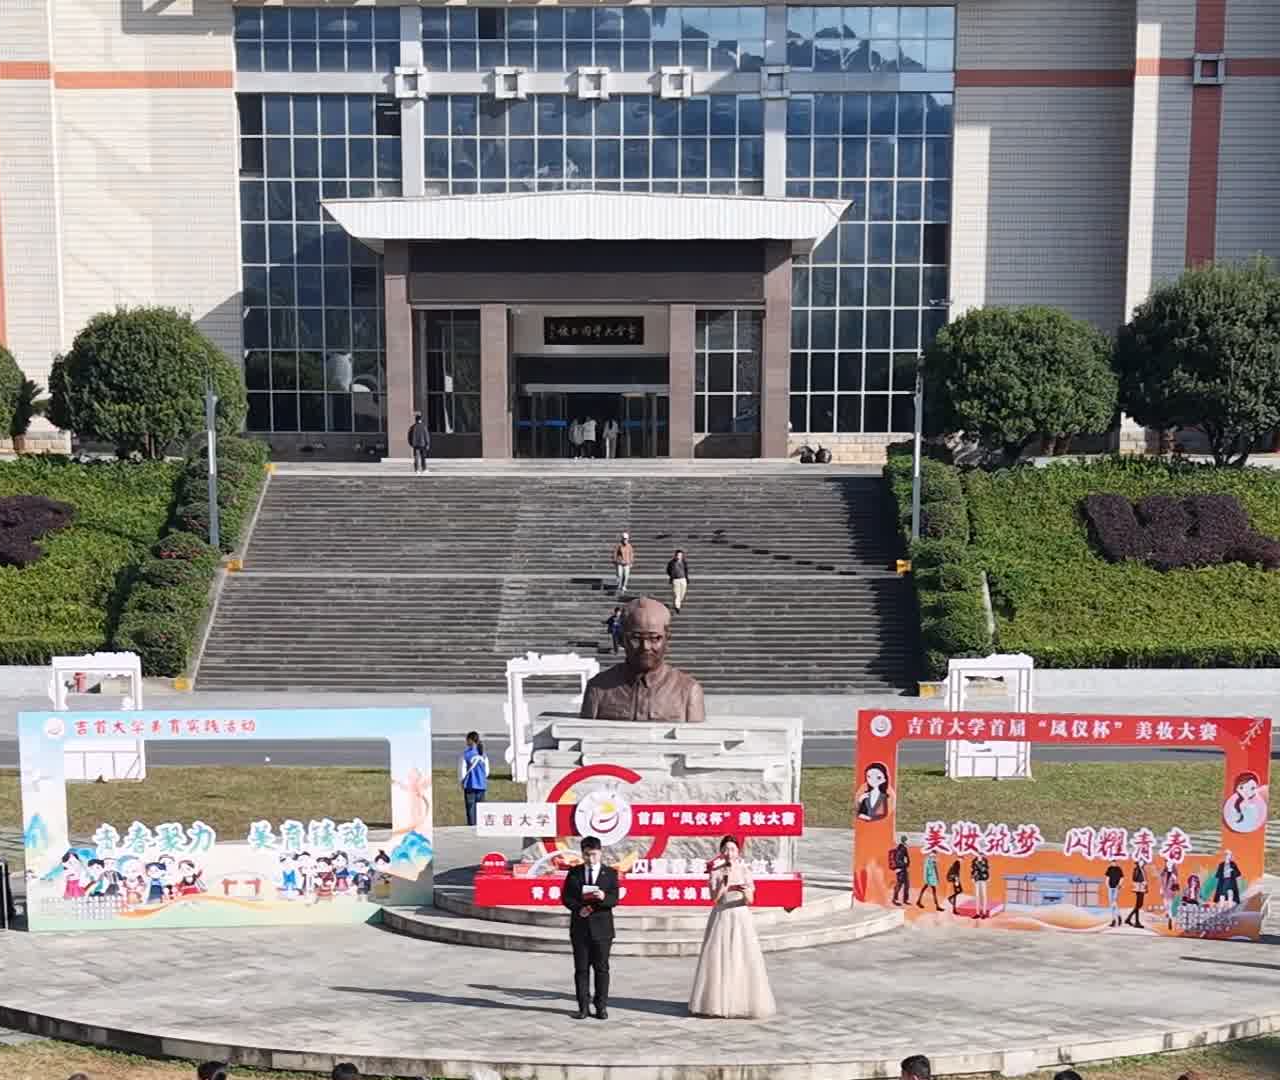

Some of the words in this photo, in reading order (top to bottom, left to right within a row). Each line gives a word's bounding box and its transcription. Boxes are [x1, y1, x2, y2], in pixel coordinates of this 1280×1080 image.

[483, 813, 551, 827] 吉首大学
[921, 822, 1045, 858] 美妆筑梦
[1063, 825, 1193, 864] 闪耀青春
